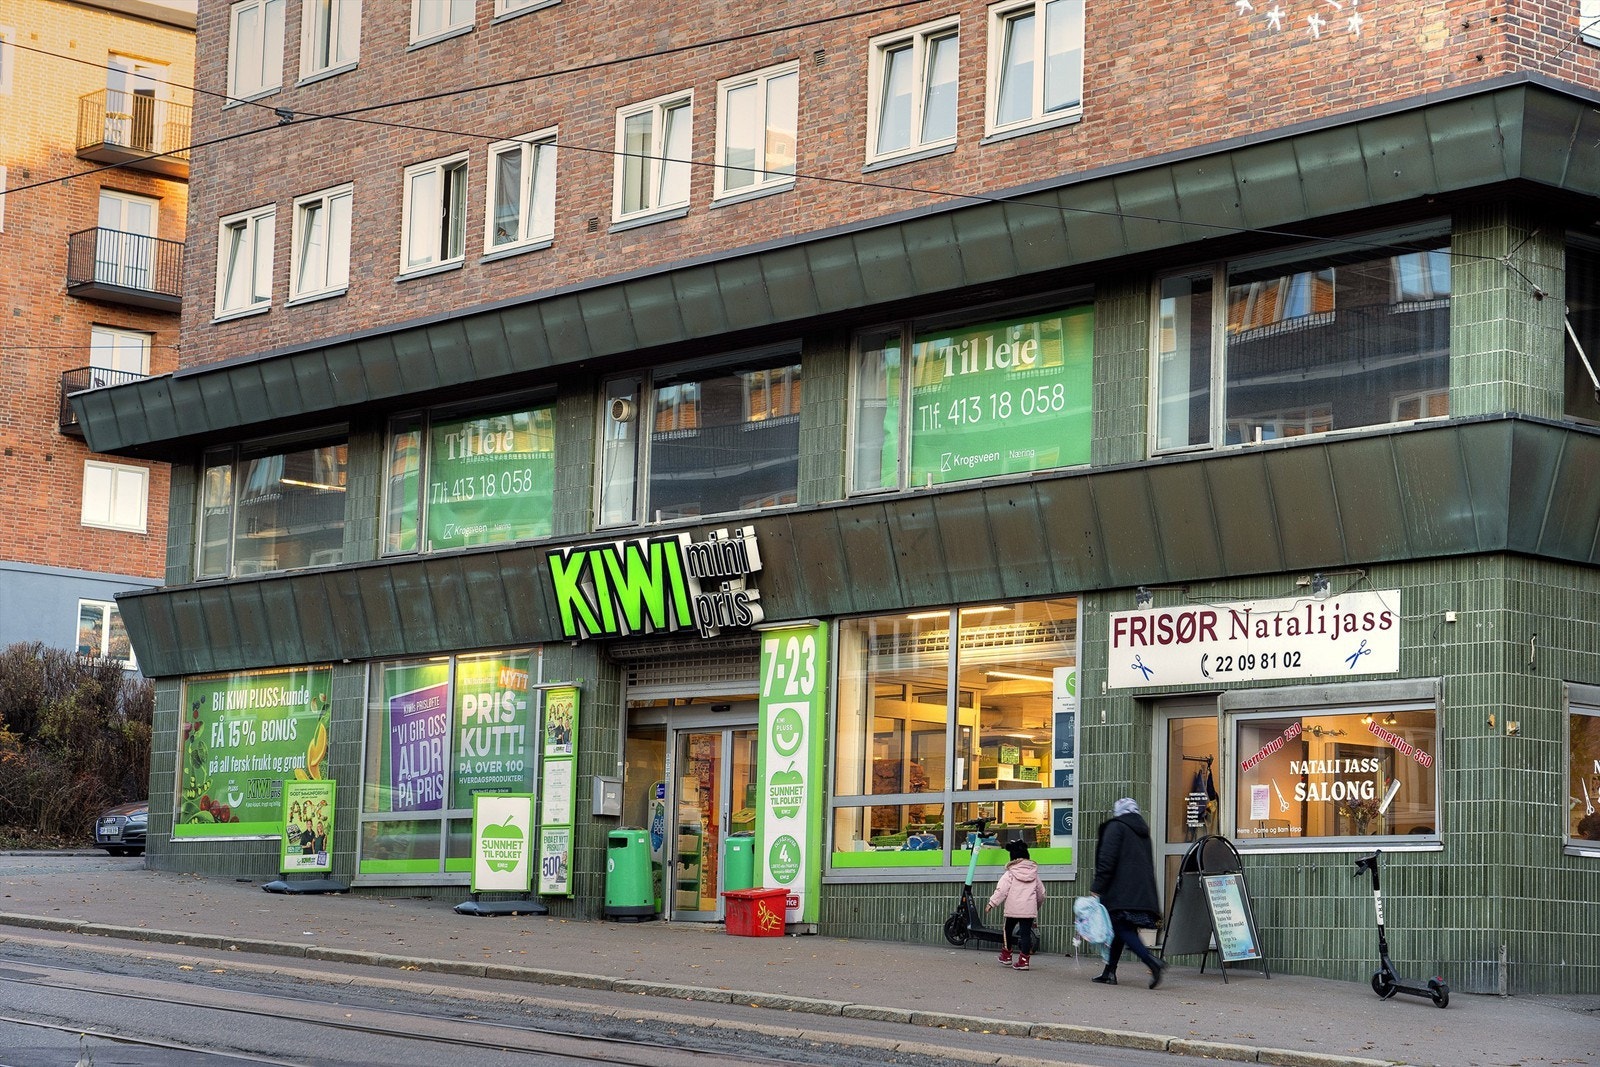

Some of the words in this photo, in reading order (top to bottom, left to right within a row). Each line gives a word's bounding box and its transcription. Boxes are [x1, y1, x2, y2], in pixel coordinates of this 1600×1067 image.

[939, 338, 979, 378] Til
[985, 331, 1038, 371] leie
[919, 402, 942, 431] Tlf.
[947, 395, 982, 425] 413
[990, 391, 1012, 420] 18
[1020, 383, 1065, 415] 058
[445, 427, 473, 460] Til
[477, 424, 514, 455] leie
[953, 451, 1000, 468] Krogsveen
[1009, 448, 1035, 460] Næring
[452, 477, 475, 501] 413
[480, 474, 496, 498] 18
[501, 468, 532, 495] 058
[454, 524, 488, 537] Krogsveen
[685, 528, 751, 578] mini
[546, 536, 694, 640] KIWI
[695, 582, 754, 639] pris
[1113, 610, 1217, 648] FRISØR
[1229, 603, 1393, 641] Natalijass
[763, 635, 815, 697] 7-23
[1215, 655, 1233, 672] 22
[1238, 654, 1256, 670] 09
[1260, 653, 1276, 669] 81
[1283, 651, 1301, 668] 02
[500, 669, 529, 690] NYTT
[212, 692, 225, 711] Bli
[226, 690, 248, 710] KIWI
[249, 685, 310, 709] PLUSS-kunde
[461, 691, 526, 725] PRIS-
[210, 715, 225, 748] FÅ
[261, 718, 297, 742] BONUS
[409, 718, 426, 741] GIR
[428, 713, 446, 737] OSS
[459, 725, 525, 758] KUTT!
[1240, 736, 1284, 773] Herreklipp
[1283, 722, 1302, 742] 250
[1368, 721, 1414, 757] Dameklipp
[1413, 747, 1434, 769] 350
[208, 755, 218, 776] på
[220, 756, 230, 773] all
[230, 755, 251, 772] fersk
[251, 753, 271, 771] frukt
[272, 758, 282, 773] og
[459, 760, 472, 774] PÅ
[475, 761, 502, 773] OVER
[505, 760, 524, 772] 100
[1289, 759, 1340, 775] NATALI
[1344, 757, 1379, 774] JASS
[247, 778, 271, 799] KIWI
[398, 774, 414, 808] PÅ
[417, 773, 443, 804] PRIS
[770, 786, 804, 796] SUNNHET
[780, 796, 803, 805] FOLKET
[1294, 779, 1375, 802] SALONG
[481, 840, 524, 850] SUNNHET
[483, 850, 494, 858] TIL
[495, 850, 522, 859] FOLKET
[543, 855, 560, 877] 500
[786, 897, 798, 906] rice
